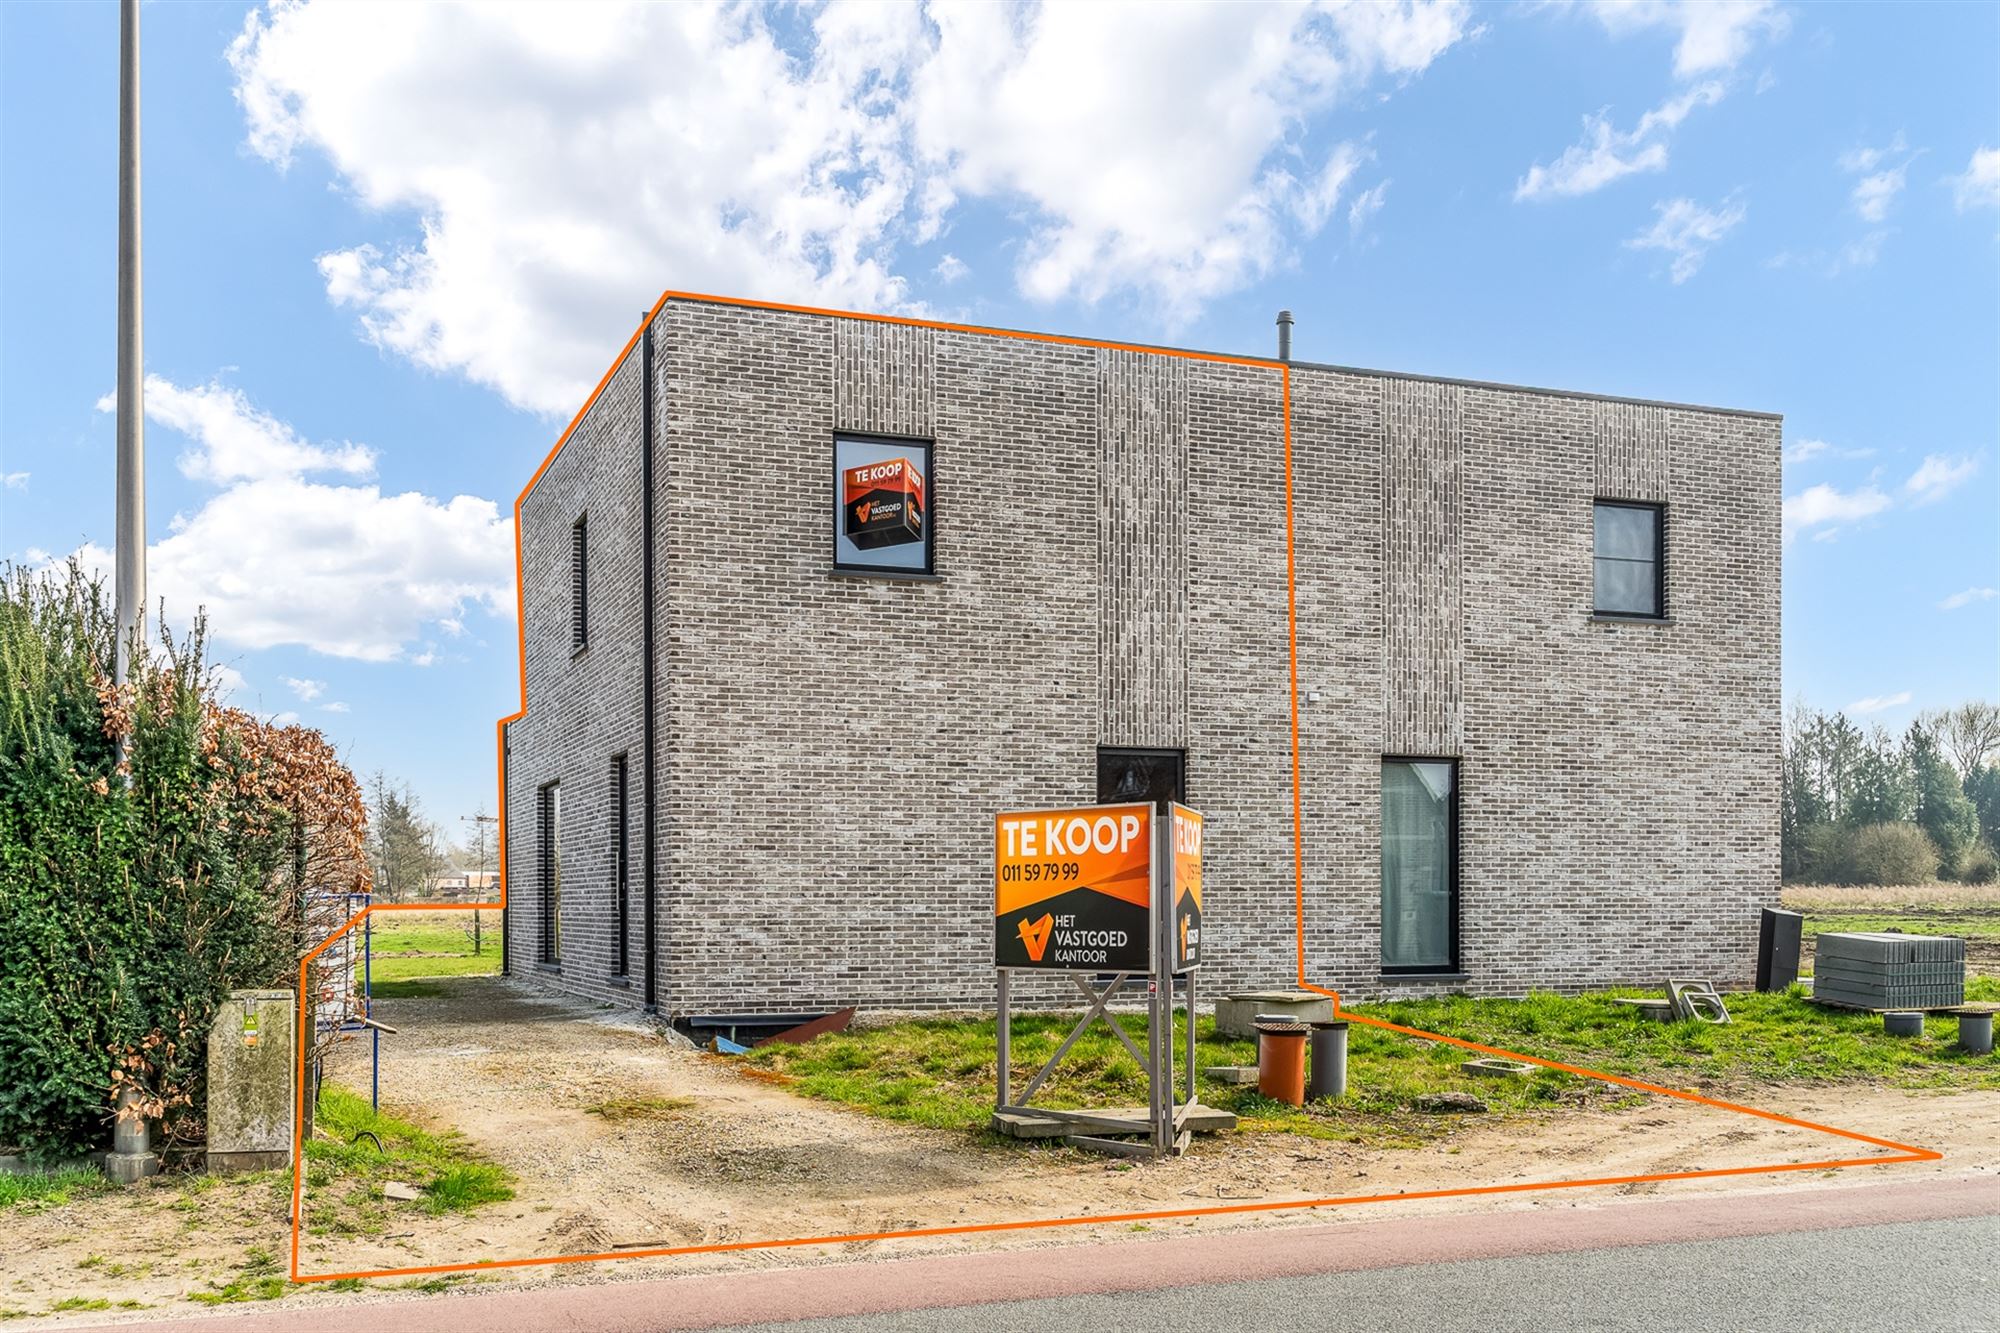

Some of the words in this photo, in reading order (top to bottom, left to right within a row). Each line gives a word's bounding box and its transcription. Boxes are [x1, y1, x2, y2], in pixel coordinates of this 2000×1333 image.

[855, 470, 868, 483] TE
[870, 462, 902, 481] KOOP
[871, 503, 902, 515] VASTGOED
[1003, 821, 1037, 857] TE
[1046, 815, 1140, 856] KOOP
[1002, 864, 1021, 881] 011
[1024, 864, 1040, 881] 59
[1043, 863, 1059, 880] 79
[1062, 862, 1079, 880] 99
[1055, 915, 1076, 927] HET
[1055, 931, 1128, 947] VASTGOED
[1055, 950, 1107, 963] KANTOOR
